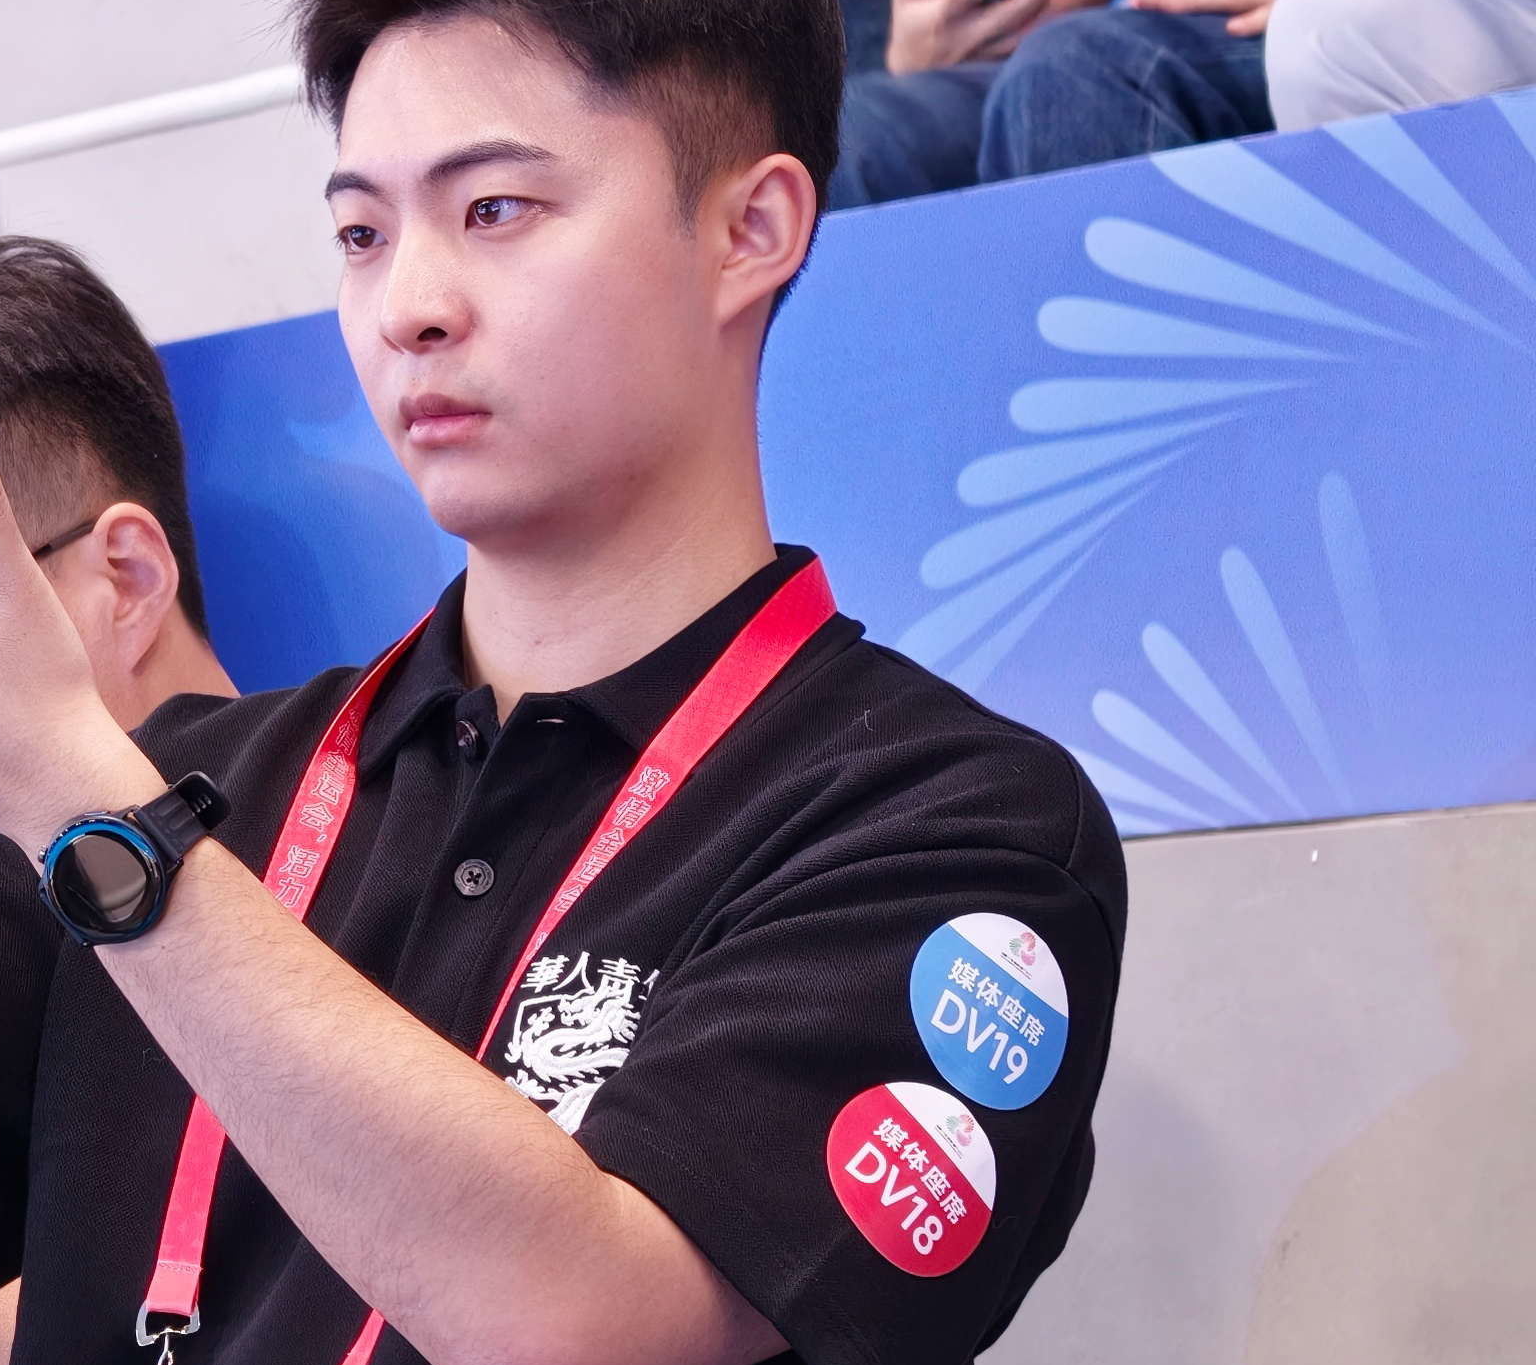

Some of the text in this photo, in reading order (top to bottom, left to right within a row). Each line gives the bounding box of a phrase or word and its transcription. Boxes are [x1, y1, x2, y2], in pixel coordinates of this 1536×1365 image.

[931, 989, 1028, 1085] DV19
[947, 957, 1046, 1047] 媒体座席
[845, 1142, 944, 1255] DV18
[873, 1117, 968, 1225] 媒体座席
